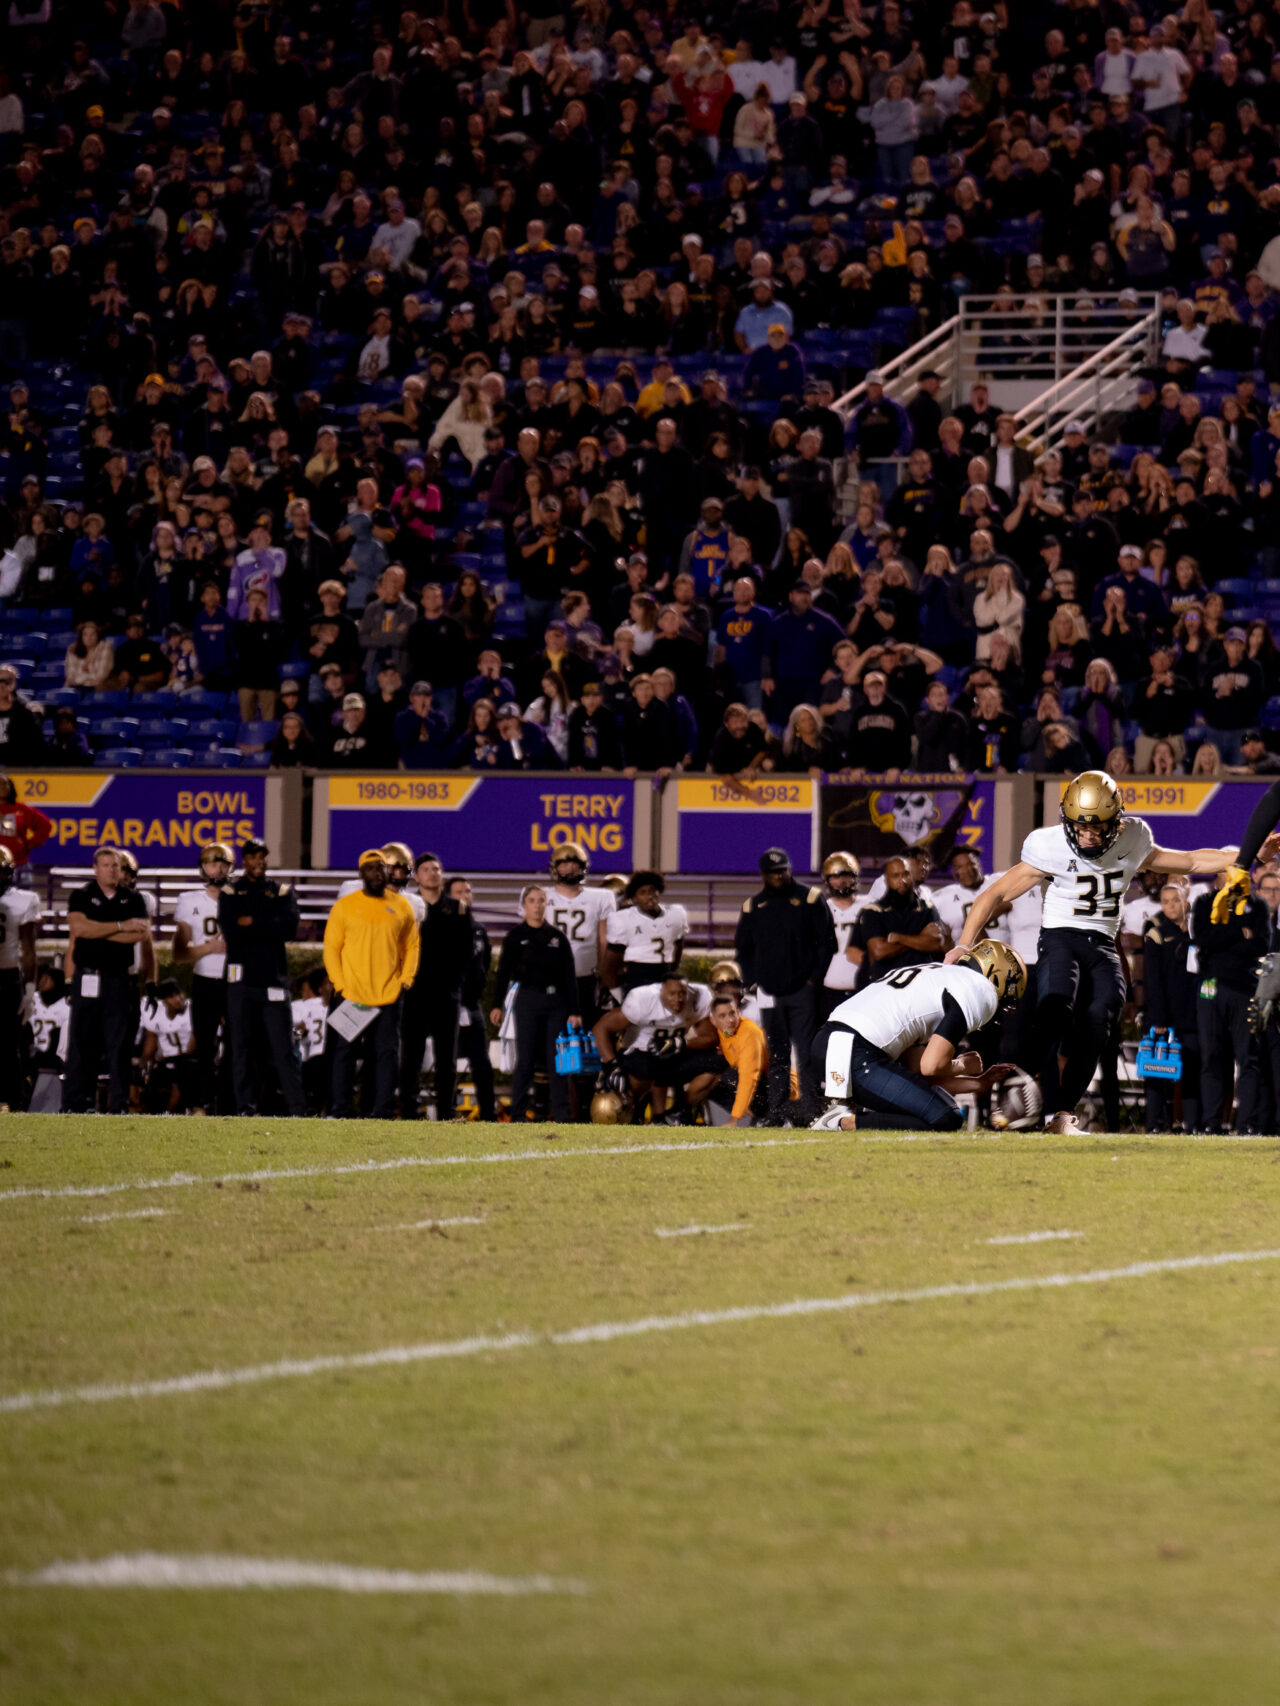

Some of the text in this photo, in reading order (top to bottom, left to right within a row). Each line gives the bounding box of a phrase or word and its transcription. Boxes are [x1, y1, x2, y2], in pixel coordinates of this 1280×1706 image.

[24, 779, 48, 797] 20
[356, 782, 450, 800] 1980-1983
[176, 791, 256, 815] BOWL
[540, 794, 624, 818] TERRY
[531, 823, 624, 852] LONG
[1072, 870, 1124, 918] 35
[553, 908, 586, 942] 52
